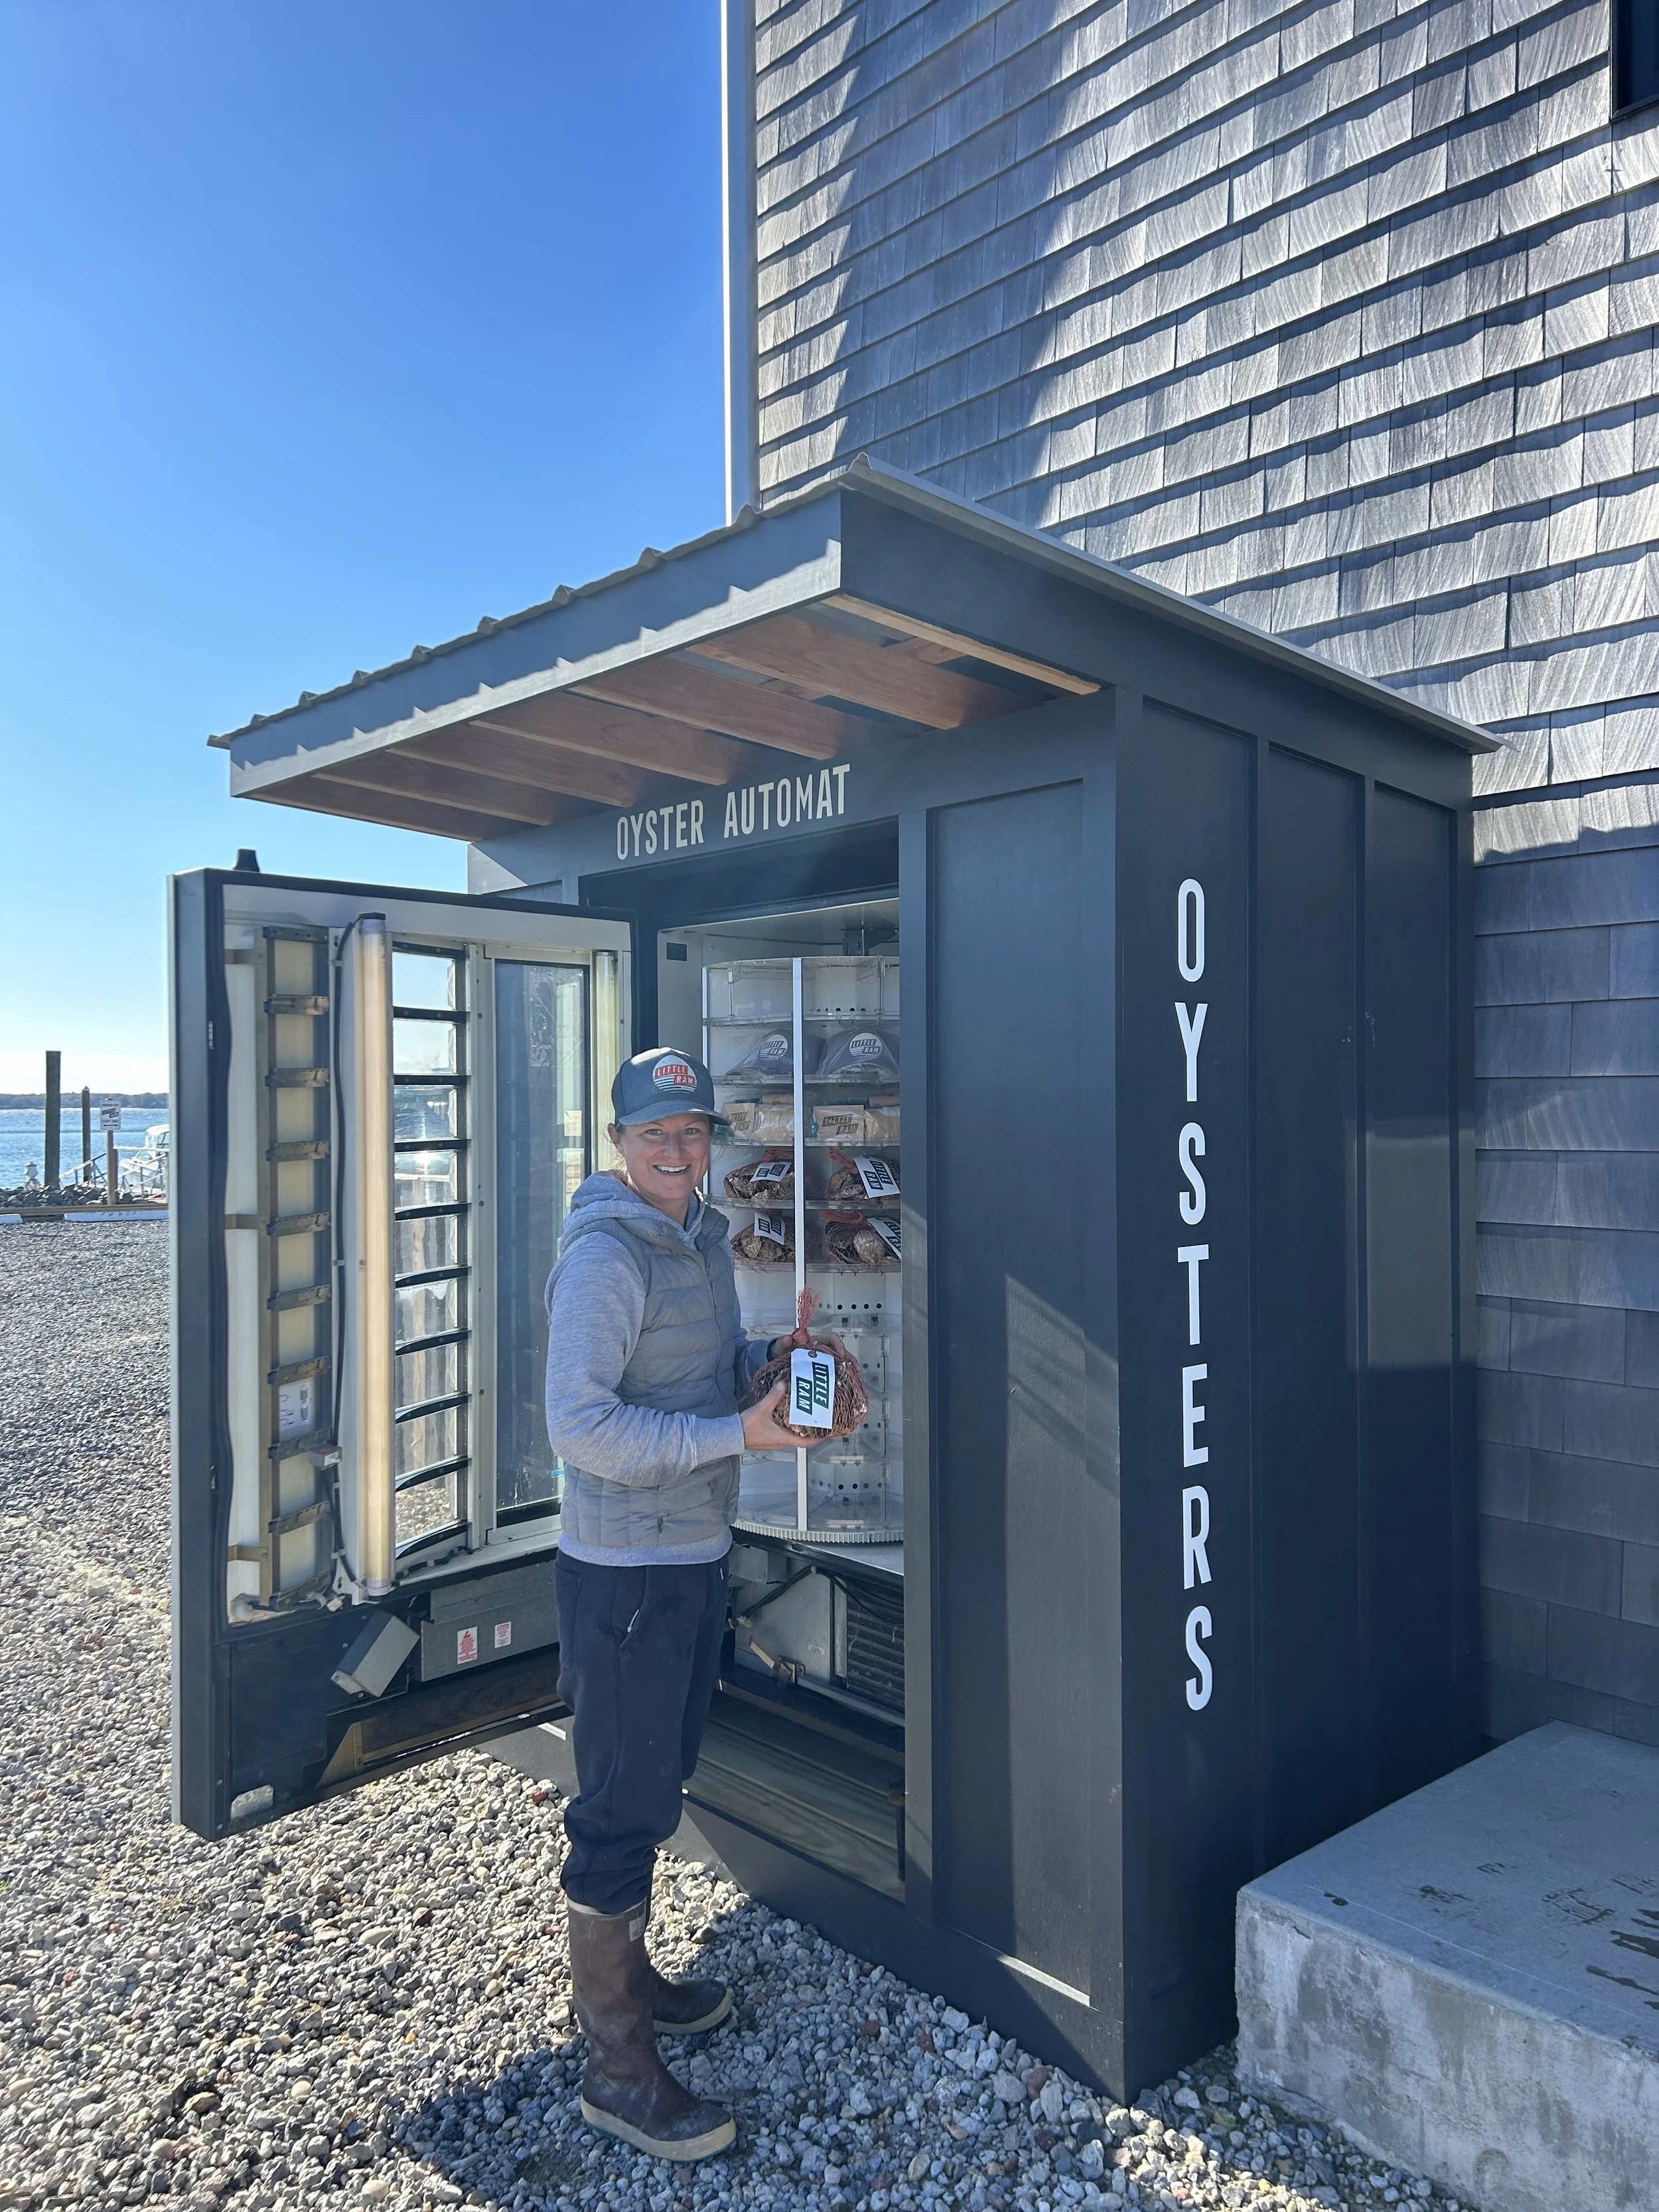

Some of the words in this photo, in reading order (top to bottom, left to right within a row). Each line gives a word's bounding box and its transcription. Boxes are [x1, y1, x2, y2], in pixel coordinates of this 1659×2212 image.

[616, 799, 704, 860] OYSTER
[723, 763, 851, 839] AUTOMAT
[657, 1065, 686, 1076] LITTLE
[676, 1075, 694, 1084] RAM
[824, 1115, 850, 1126] LITTLE
[839, 1125, 857, 1134] RAM
[865, 1172, 881, 1188] RAM
[873, 1162, 892, 1183] LITTLE
[1175, 878, 1214, 1712] OYSTERS
[814, 1363, 828, 1406] LITTLE
[798, 1380, 811, 1411] RAM
